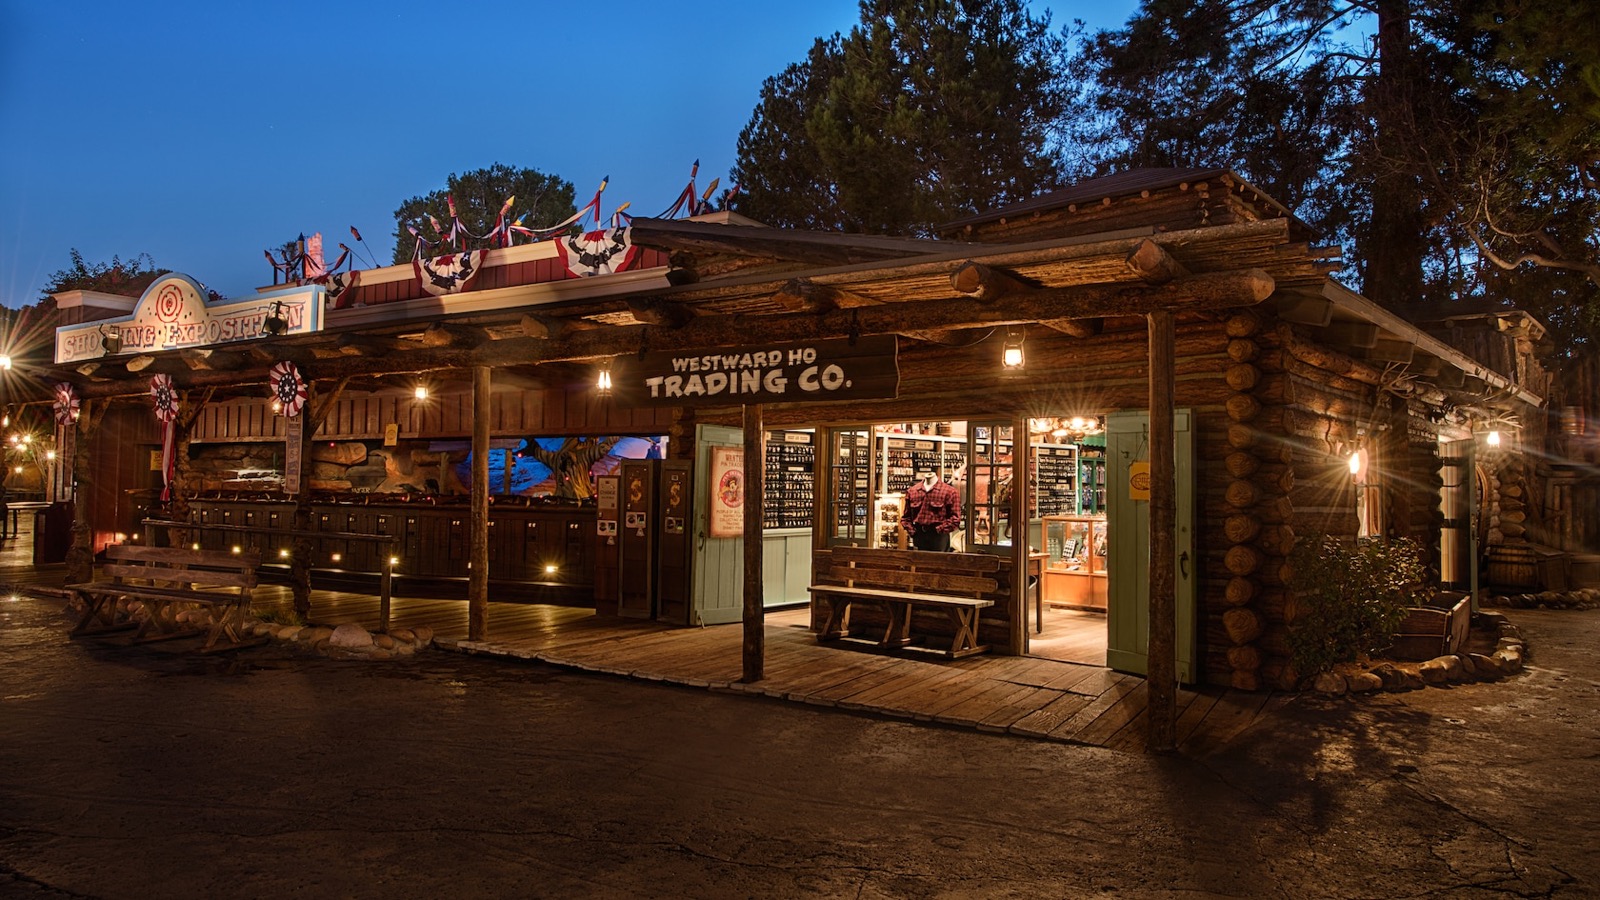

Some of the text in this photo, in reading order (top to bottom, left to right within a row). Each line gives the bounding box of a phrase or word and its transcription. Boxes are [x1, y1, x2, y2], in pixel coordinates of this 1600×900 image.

[63, 303, 304, 361] SHOING EXPOSITIN
[672, 347, 817, 372] WESTWARD HO
[645, 363, 853, 398] TRADING CO.
